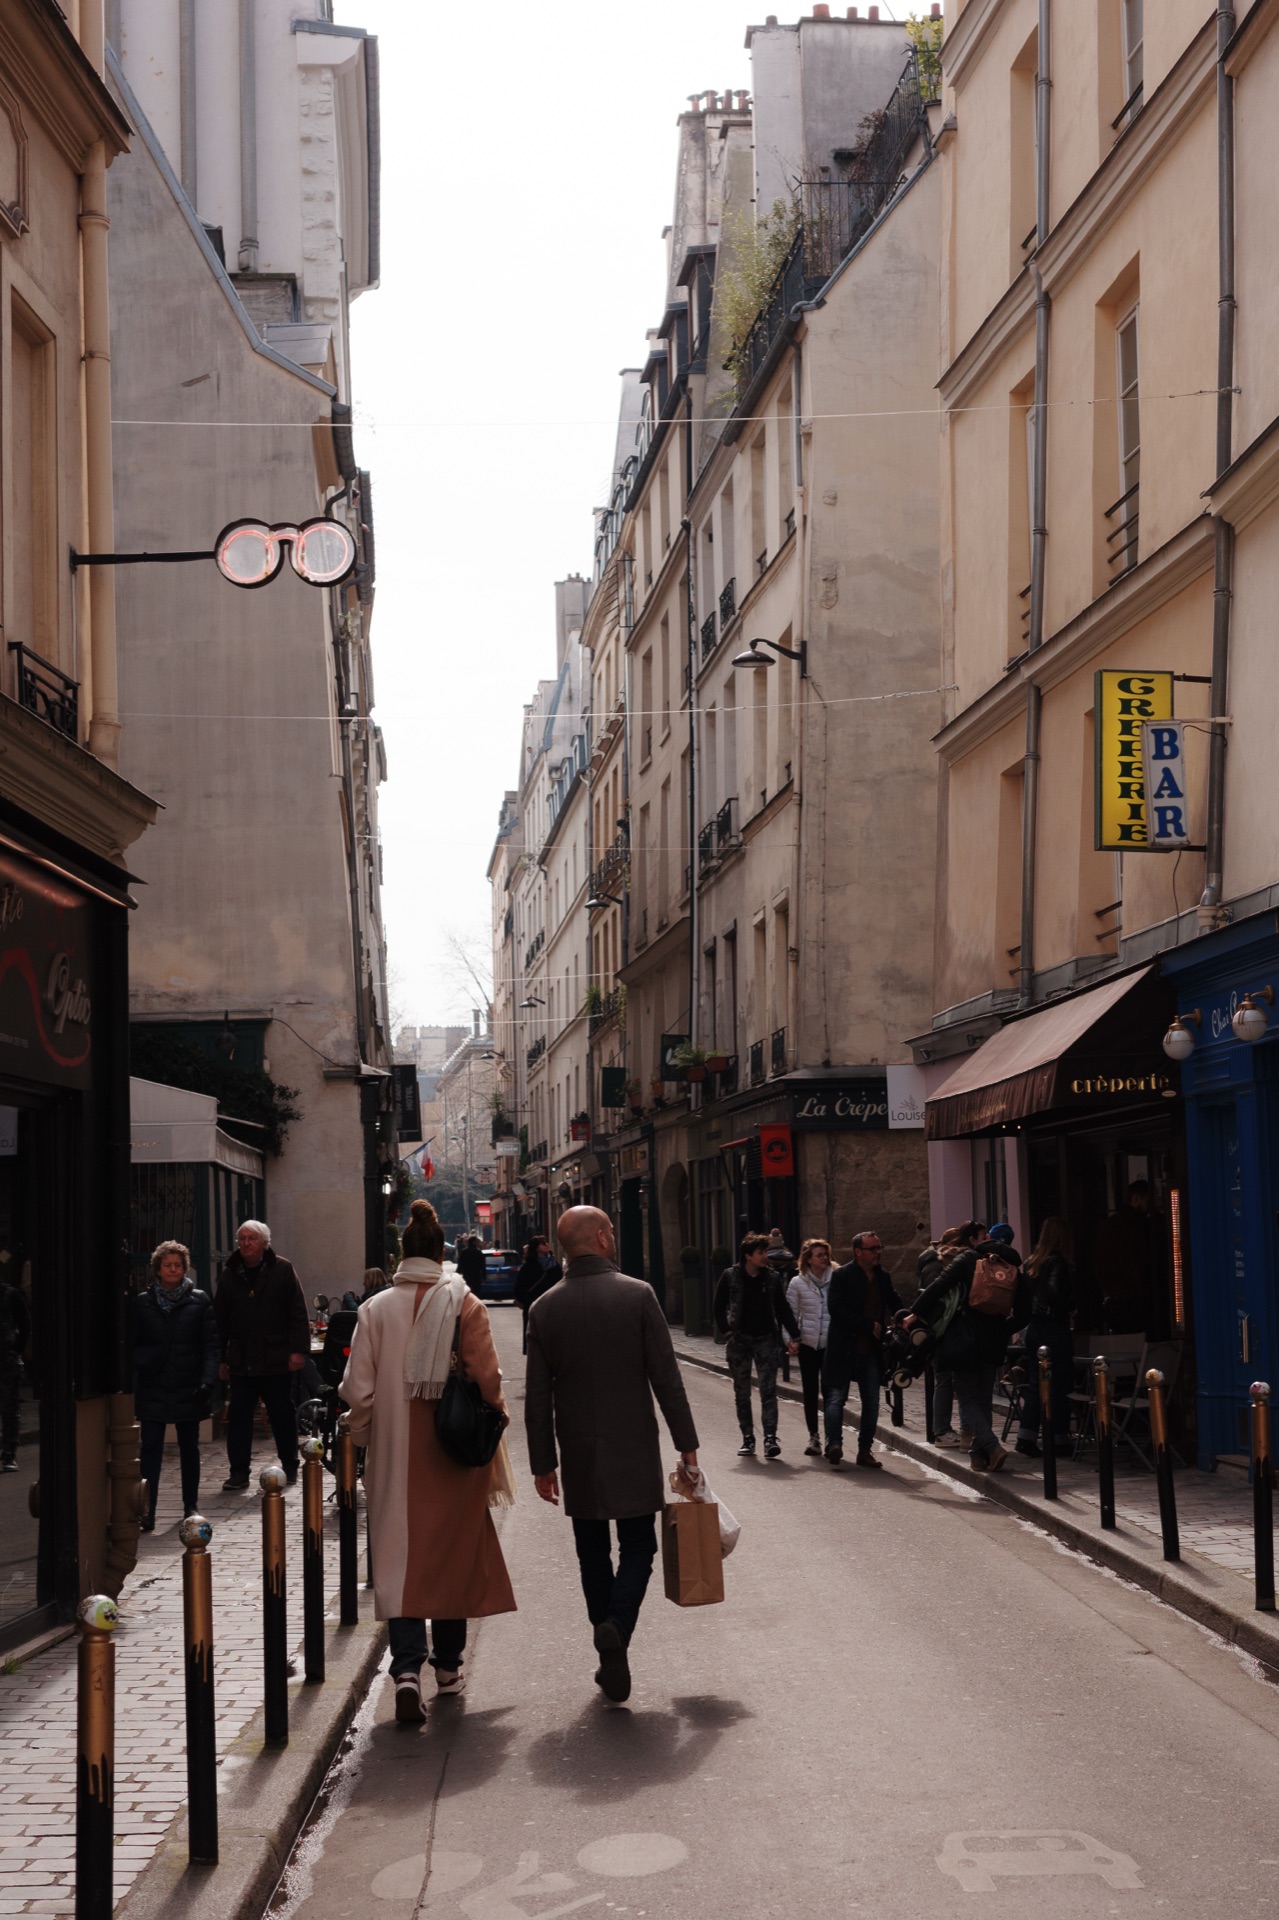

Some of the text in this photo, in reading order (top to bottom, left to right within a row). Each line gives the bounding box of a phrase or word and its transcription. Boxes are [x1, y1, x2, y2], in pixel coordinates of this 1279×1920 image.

[1151, 728, 1187, 838] BAR
[796, 1096, 888, 1122] La Crêpe
